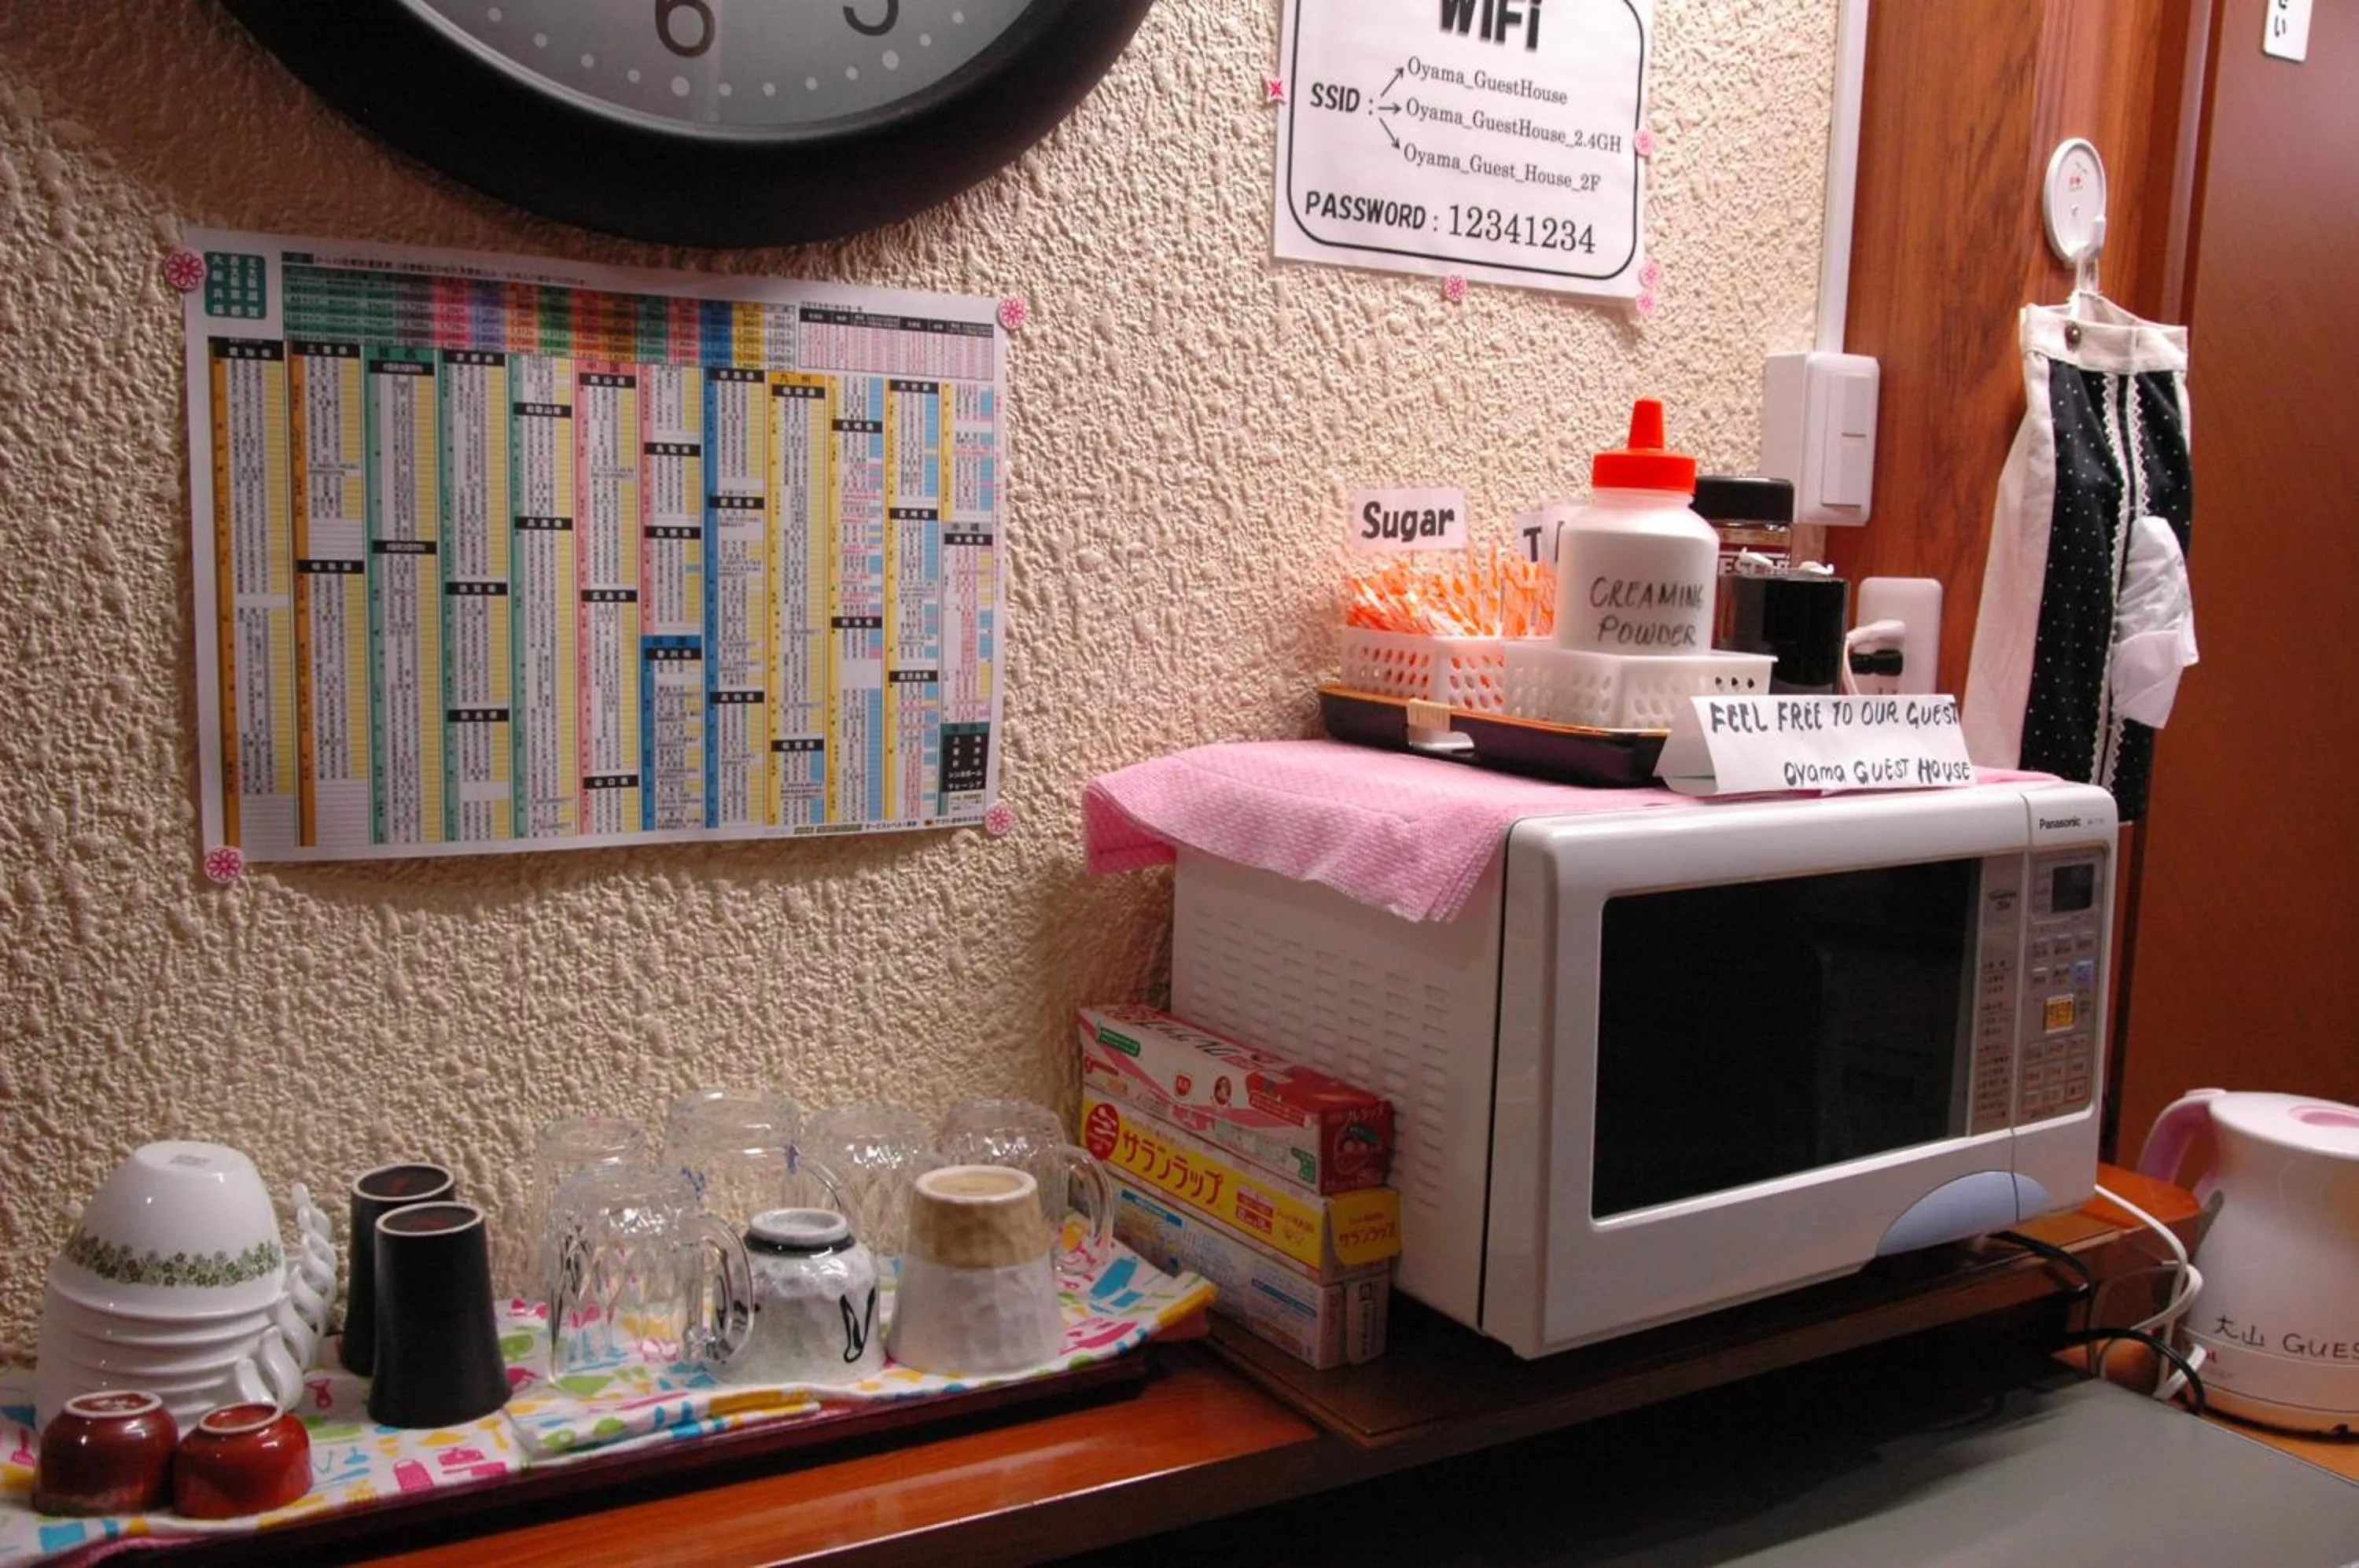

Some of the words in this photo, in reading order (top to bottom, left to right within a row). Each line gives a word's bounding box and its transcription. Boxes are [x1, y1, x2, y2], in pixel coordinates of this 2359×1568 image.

[1408, 56, 1567, 105] Oyama_GuestHouse
[1448, 204, 1595, 253] 12341234
[1362, 501, 1454, 543] Sugar
[1597, 615, 1698, 646] POWDER
[1777, 701, 1823, 731] FREE
[1861, 701, 1898, 726] OUR
[2039, 815, 2081, 830] Panasonic
[1123, 1131, 1224, 1205] サランラップ
